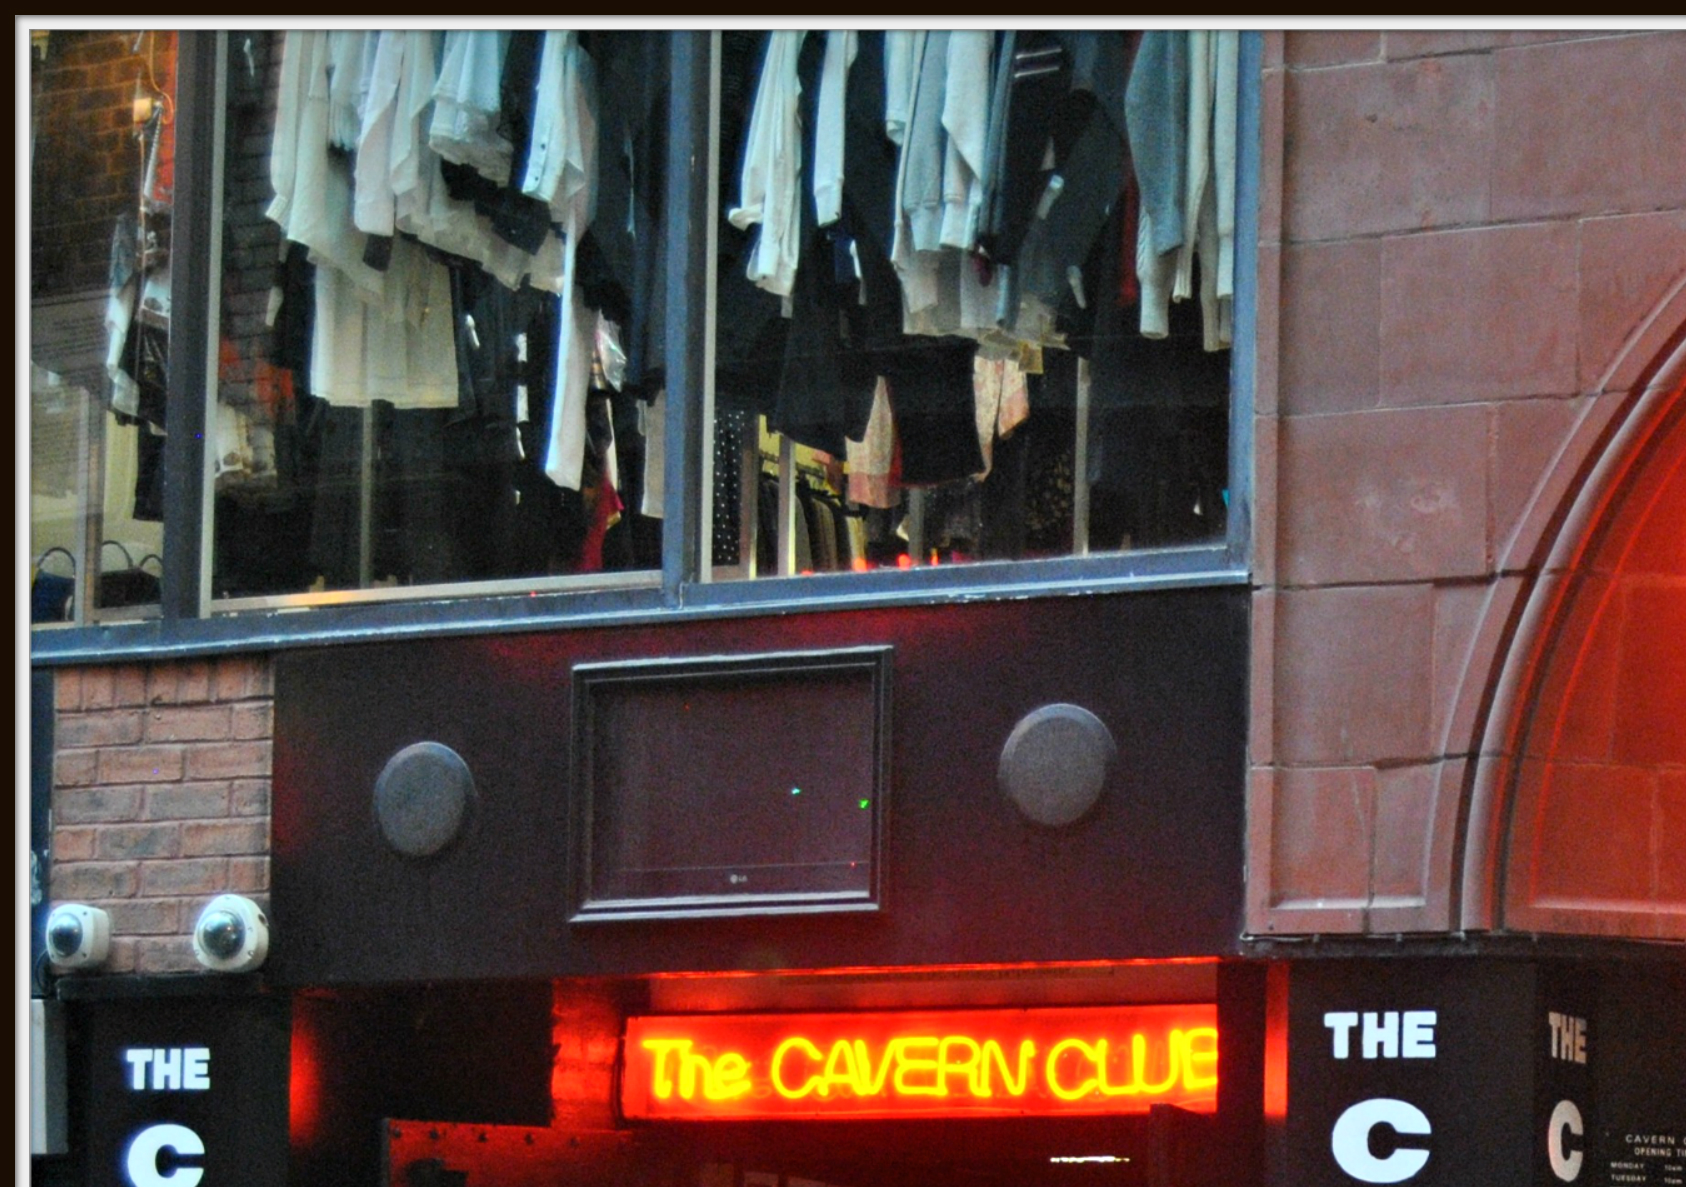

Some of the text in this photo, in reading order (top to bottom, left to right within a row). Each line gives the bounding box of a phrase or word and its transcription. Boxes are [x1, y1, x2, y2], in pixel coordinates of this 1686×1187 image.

[1324, 1011, 1437, 1059] THE
[1548, 1011, 1588, 1064] THE
[127, 1048, 210, 1090] THE
[644, 1038, 750, 1100] The
[770, 1035, 1035, 1098] CAVERN
[1625, 1134, 1676, 1145] CAVERN
[1634, 1147, 1672, 1157] OPENING
[1610, 1161, 1645, 1170] MONDAY
[1610, 1174, 1647, 1182] TUESDAY
